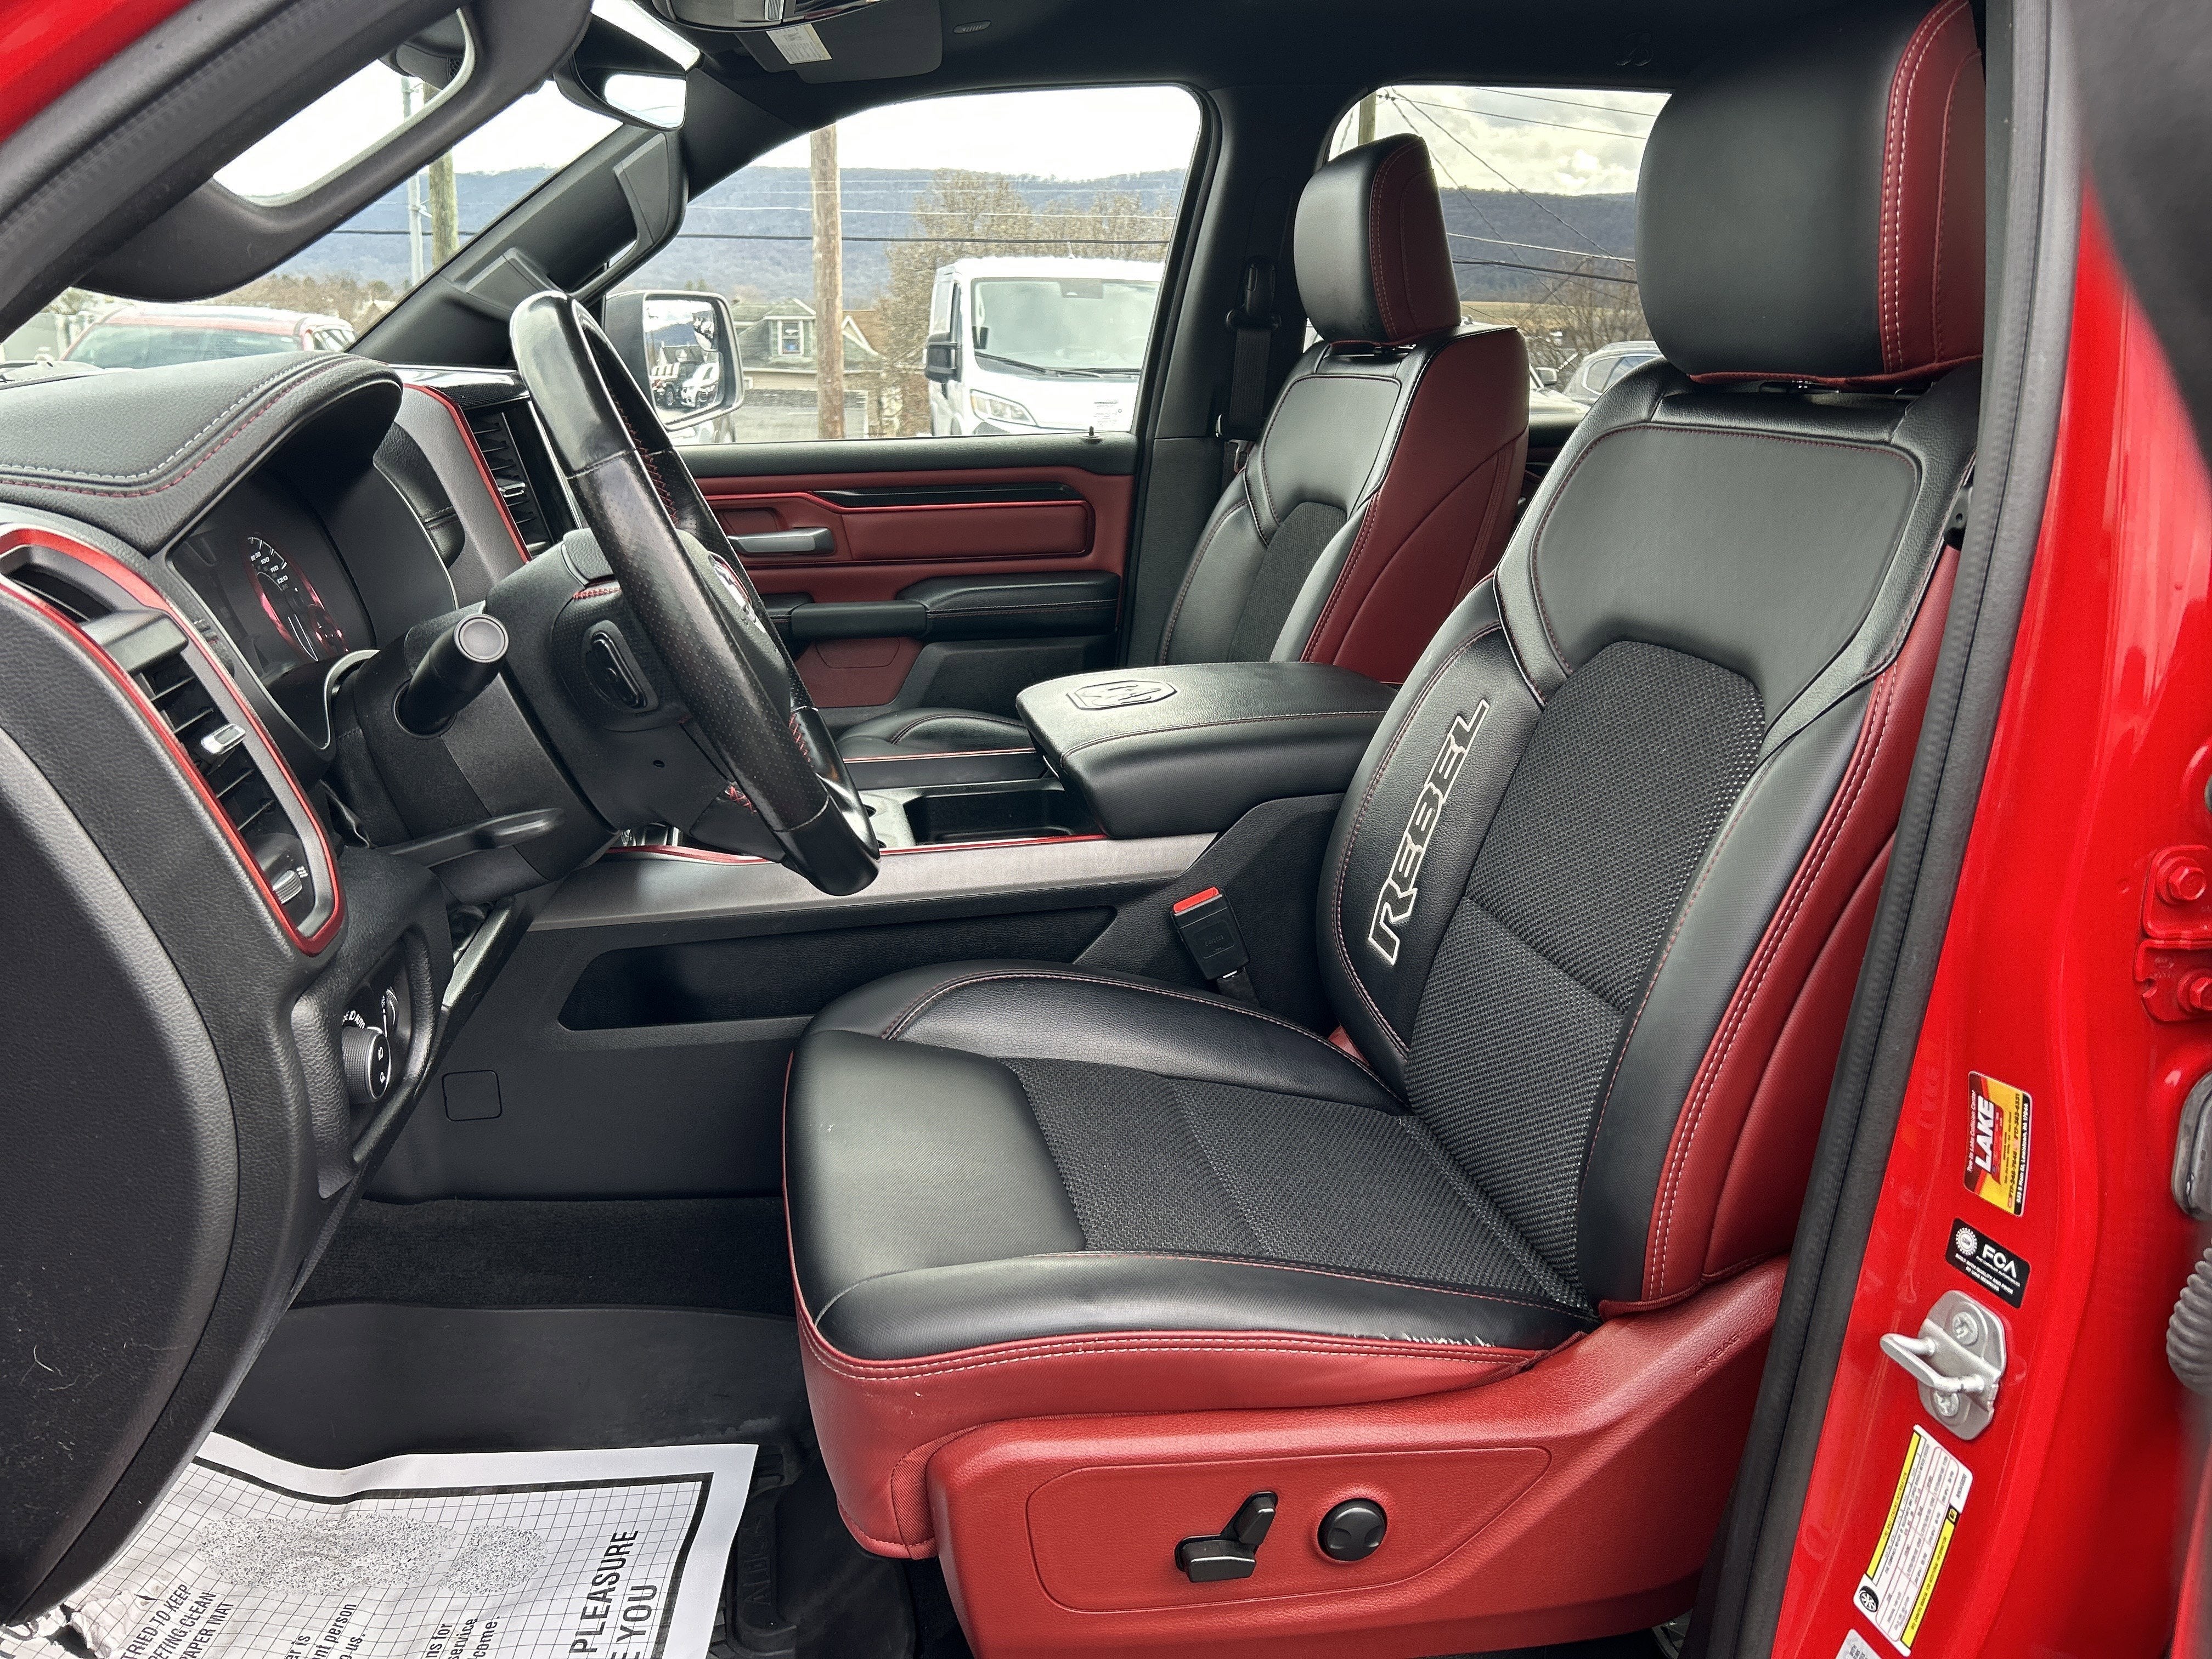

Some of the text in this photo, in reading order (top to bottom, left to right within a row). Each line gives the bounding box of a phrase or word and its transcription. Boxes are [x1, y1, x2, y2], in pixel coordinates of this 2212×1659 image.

[277, 575, 289, 584] 120
[1368, 698, 1489, 966] REBEL
[1974, 1094, 1995, 1172] LAKE
[1982, 1244, 2017, 1279] FCA
[179, 1592, 217, 1627] CLEAN
[569, 1530, 639, 1653] PLEASURE
[616, 1584, 658, 1643] YOU
[120, 1584, 191, 1659] TRIED TO KEEP
[178, 1601, 235, 1659] APER MAT
[291, 1635, 311, 1646] is
[311, 1604, 357, 1659] nt person
[431, 1623, 453, 1640] for
[467, 1616, 501, 1659] come.
